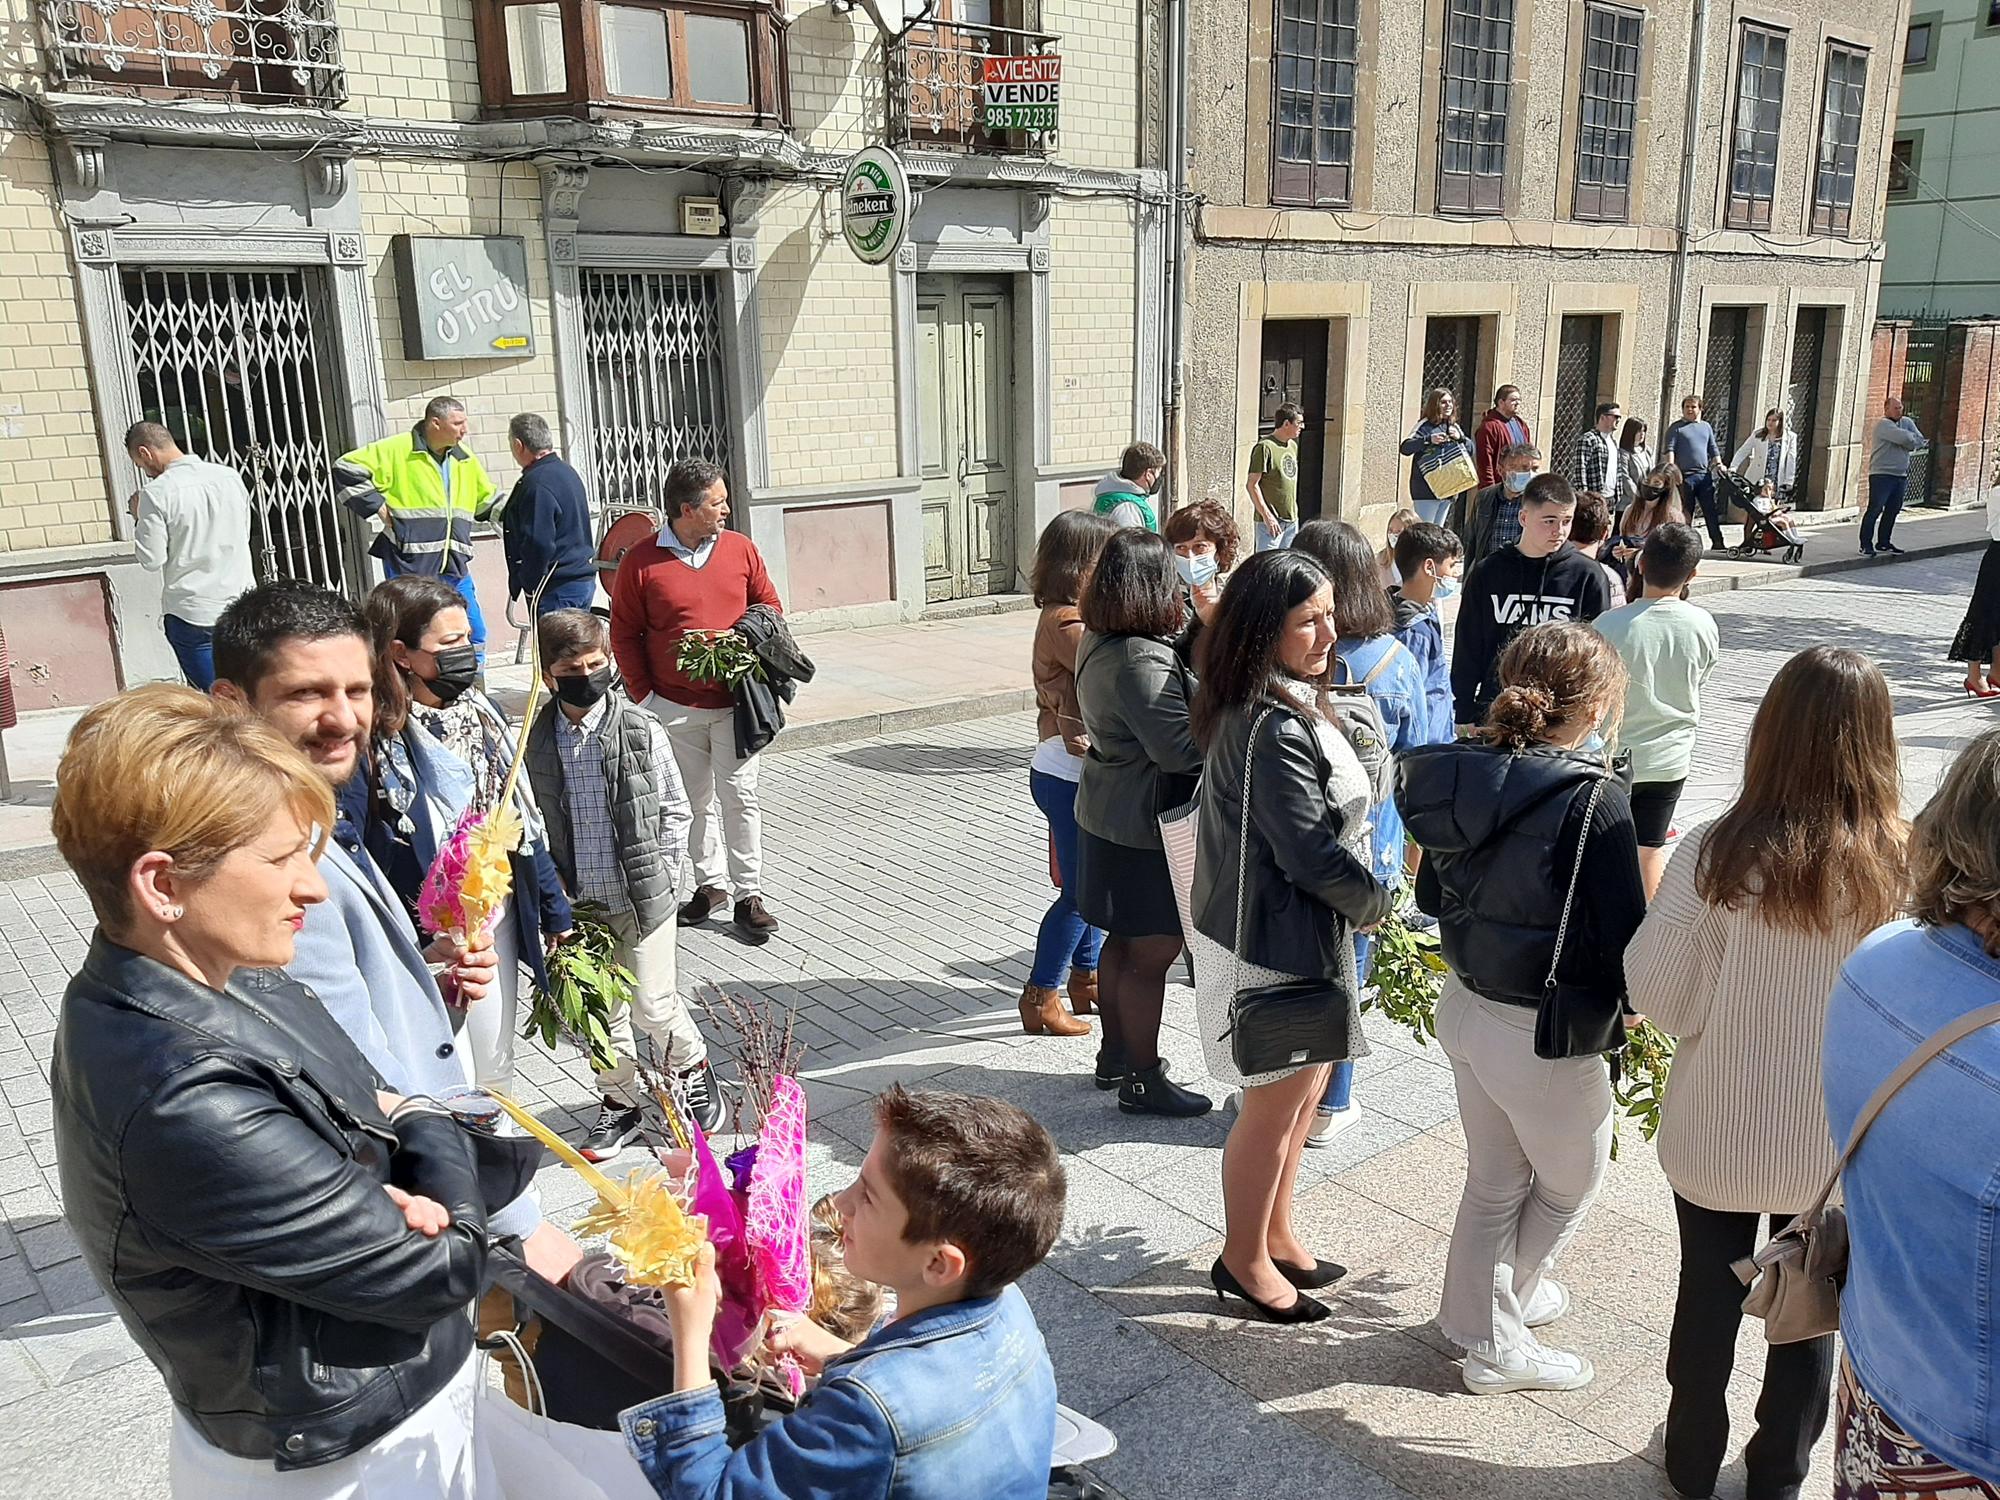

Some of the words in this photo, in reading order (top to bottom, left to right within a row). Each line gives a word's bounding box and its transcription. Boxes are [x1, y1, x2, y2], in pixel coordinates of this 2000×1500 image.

[995, 58, 1060, 80] VICENTIZ
[987, 84, 1059, 103] VENDE
[987, 107, 1012, 127] 985
[430, 261, 472, 301] EL
[437, 276, 519, 344] OTRU
[1490, 594, 1575, 626] VANS
